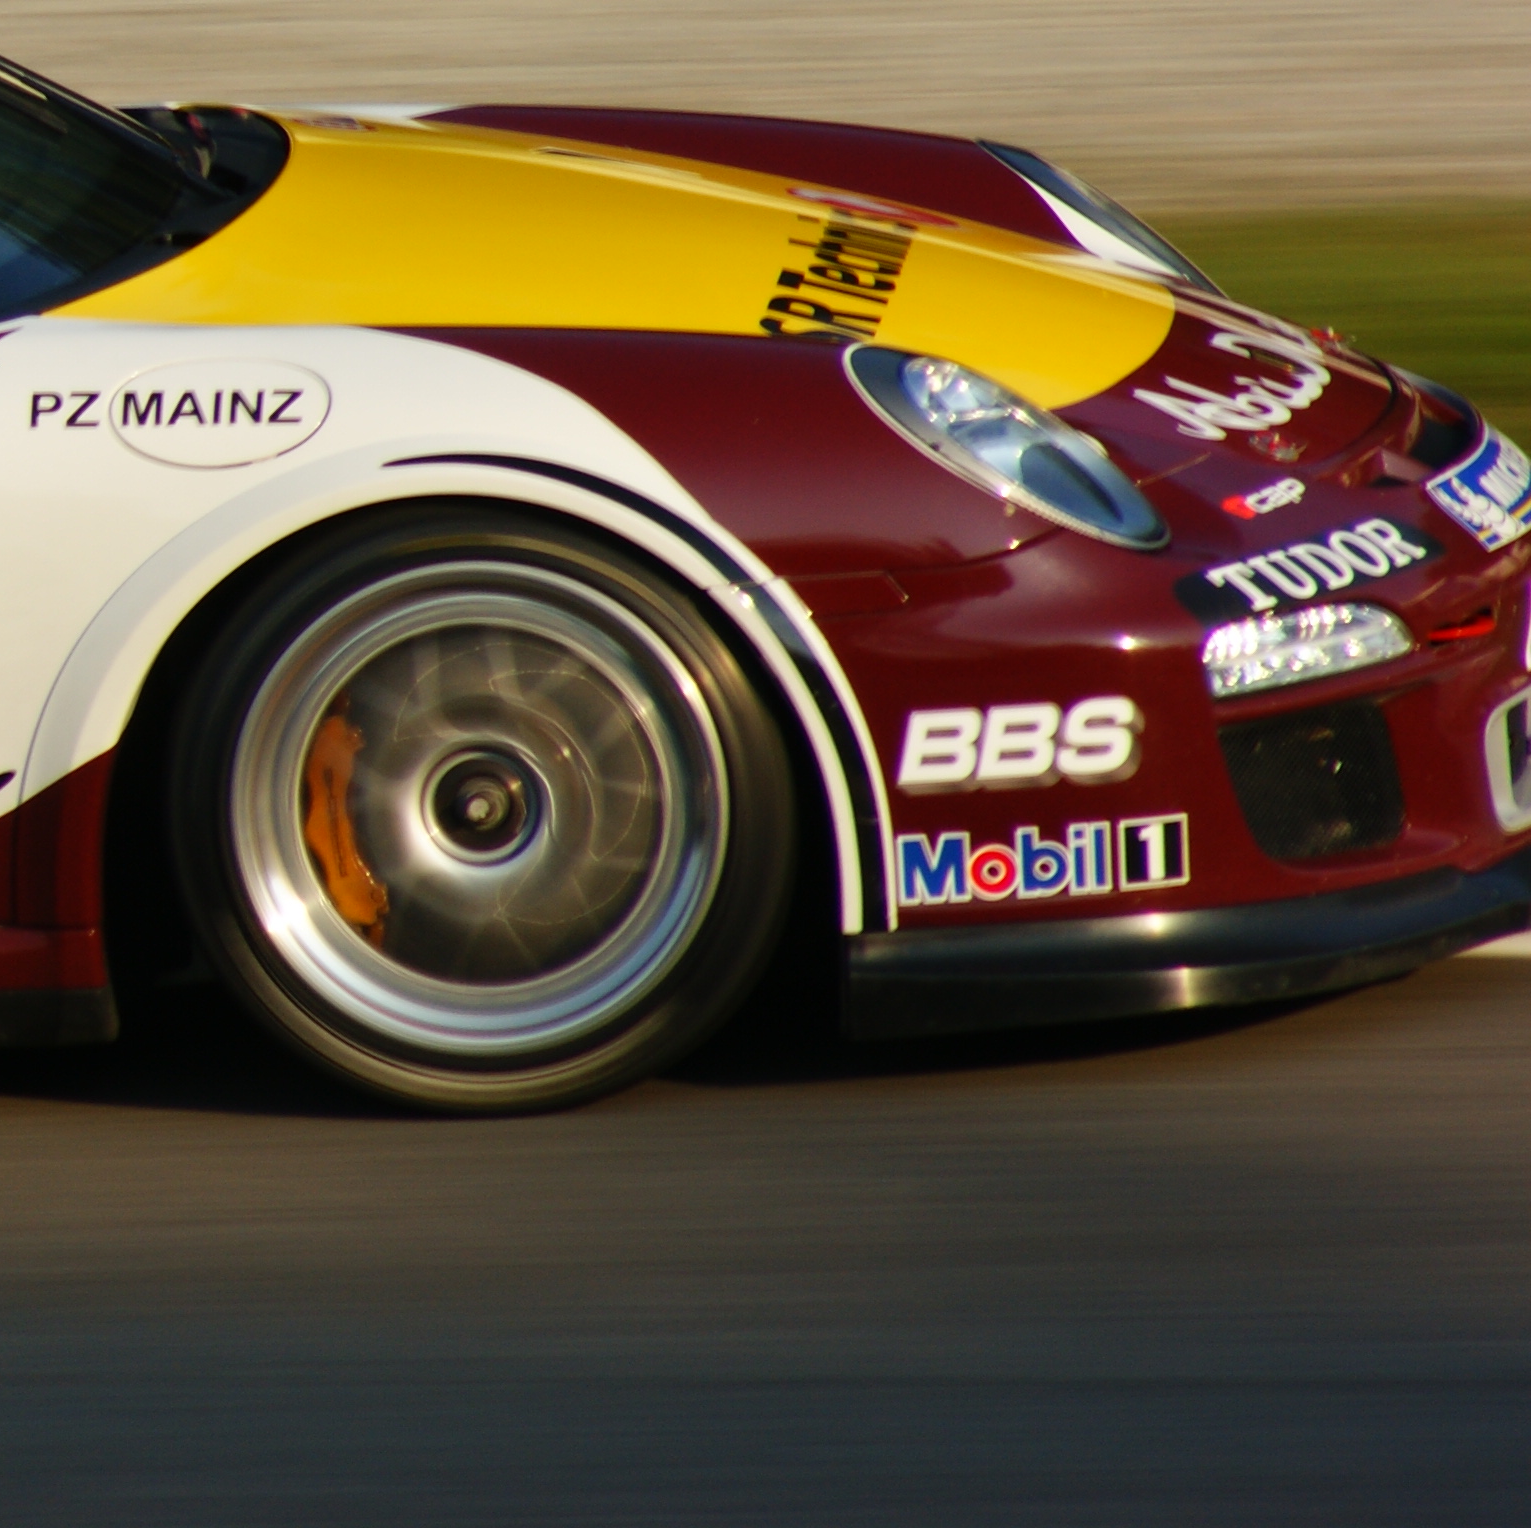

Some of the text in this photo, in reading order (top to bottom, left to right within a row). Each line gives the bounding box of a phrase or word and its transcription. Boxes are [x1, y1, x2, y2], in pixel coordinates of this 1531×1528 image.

[29, 389, 304, 429] PZ MAINZ
[1204, 517, 1427, 612] TUDOR
[897, 696, 1142, 792] BBS
[896, 820, 1111, 907] Mobil
